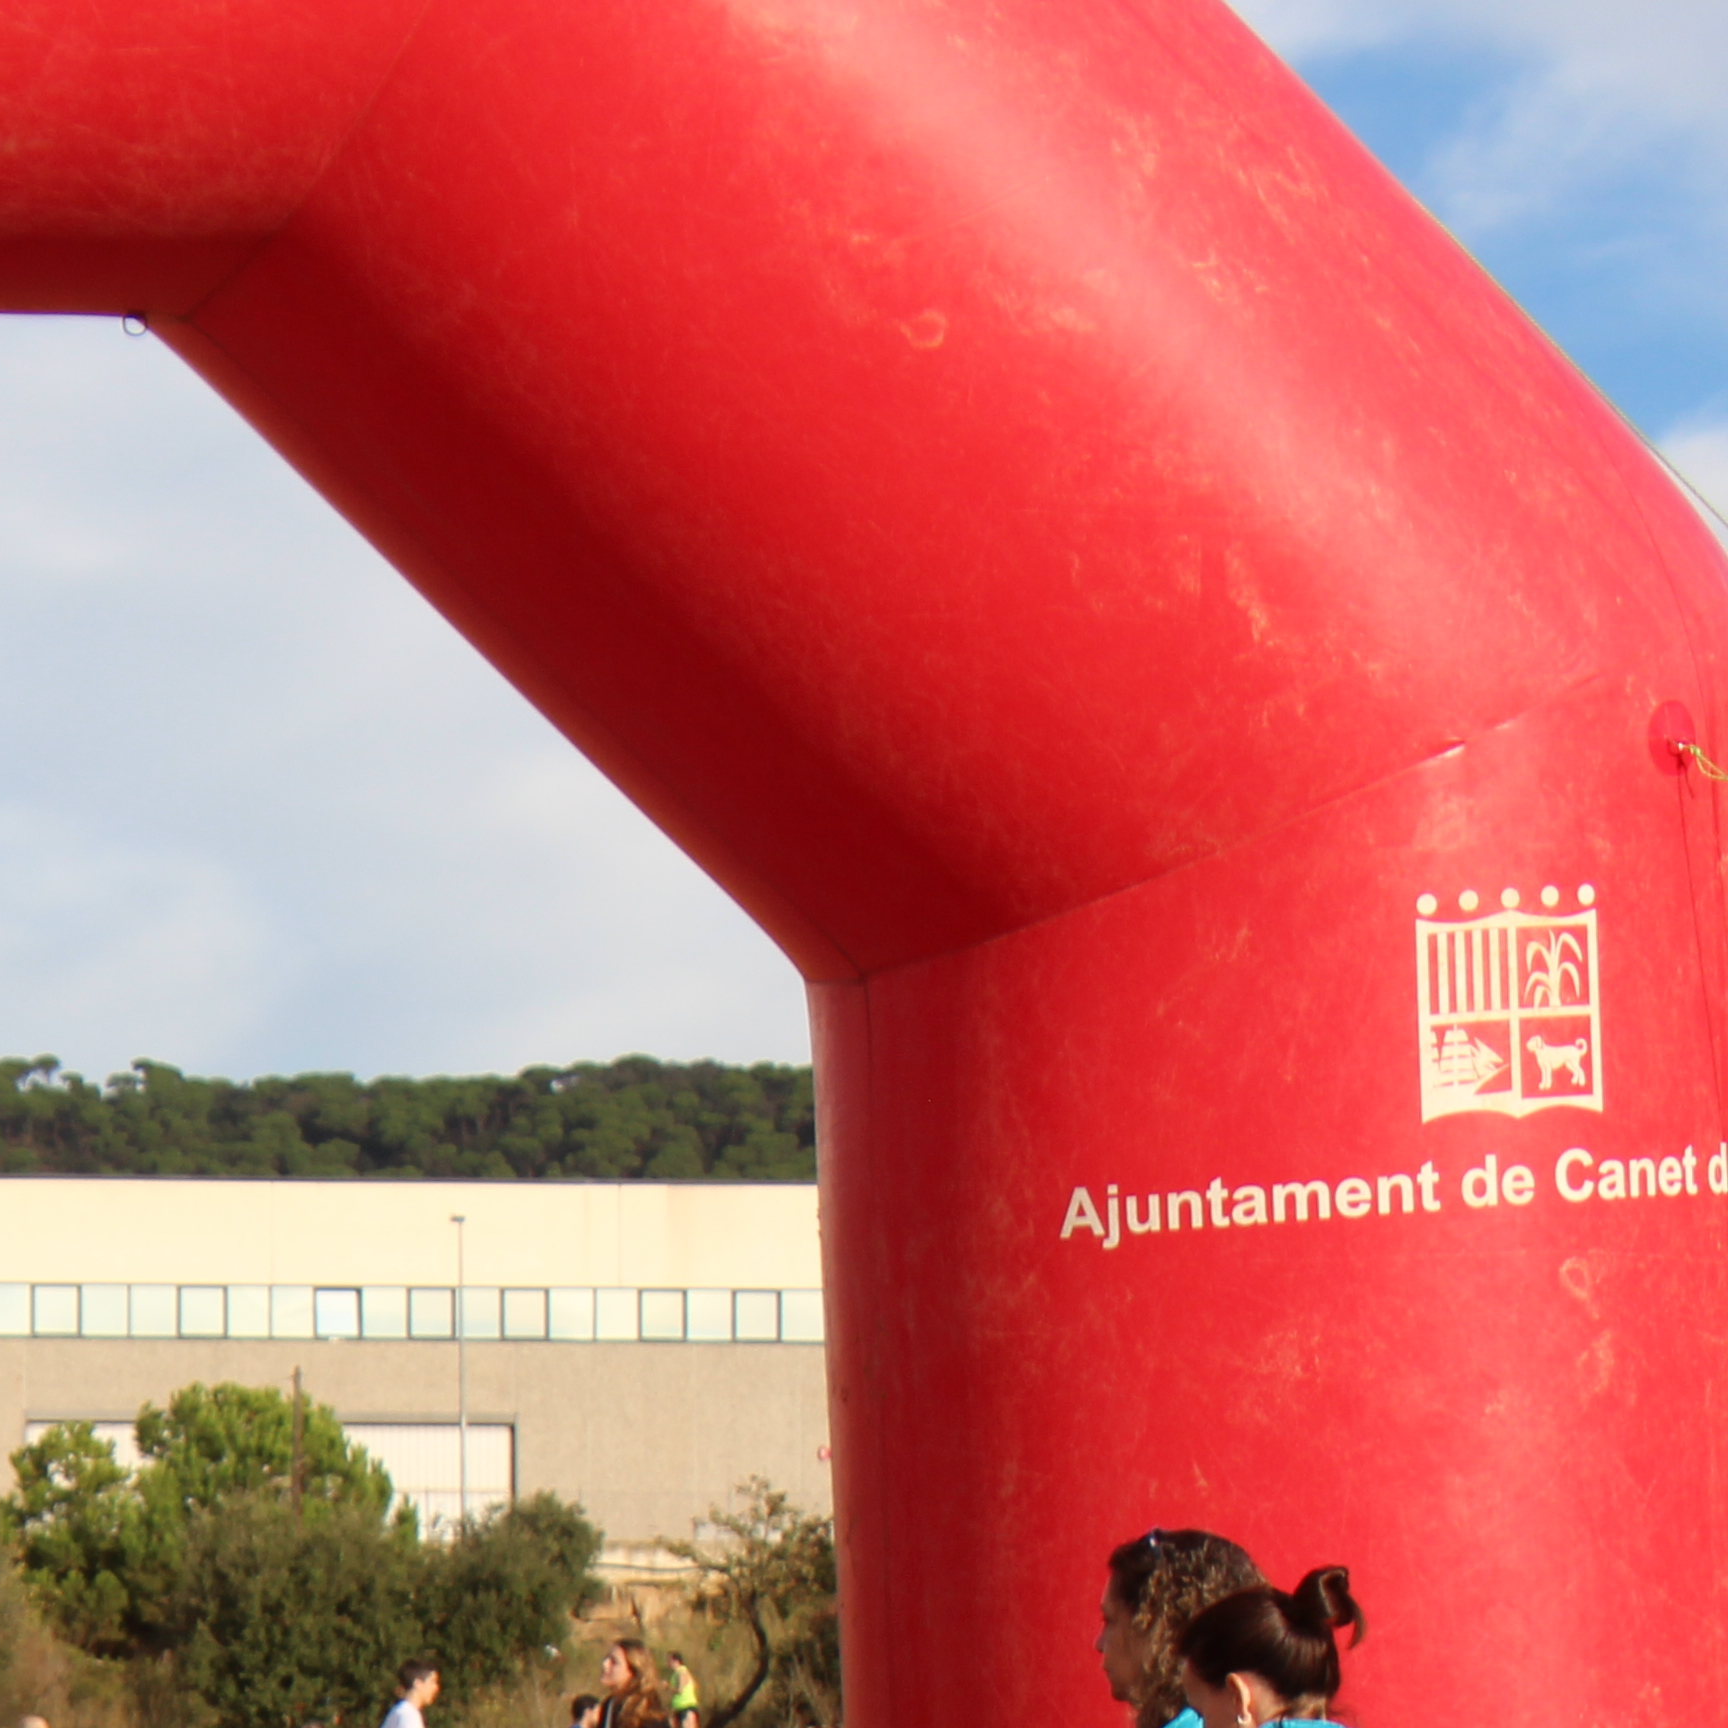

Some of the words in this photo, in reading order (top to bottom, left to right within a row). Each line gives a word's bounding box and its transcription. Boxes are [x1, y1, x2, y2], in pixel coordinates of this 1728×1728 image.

[1060, 1161, 1440, 1249] Ajuntament
[1460, 1154, 1535, 1208] de
[1554, 1146, 1698, 1203] Canet
